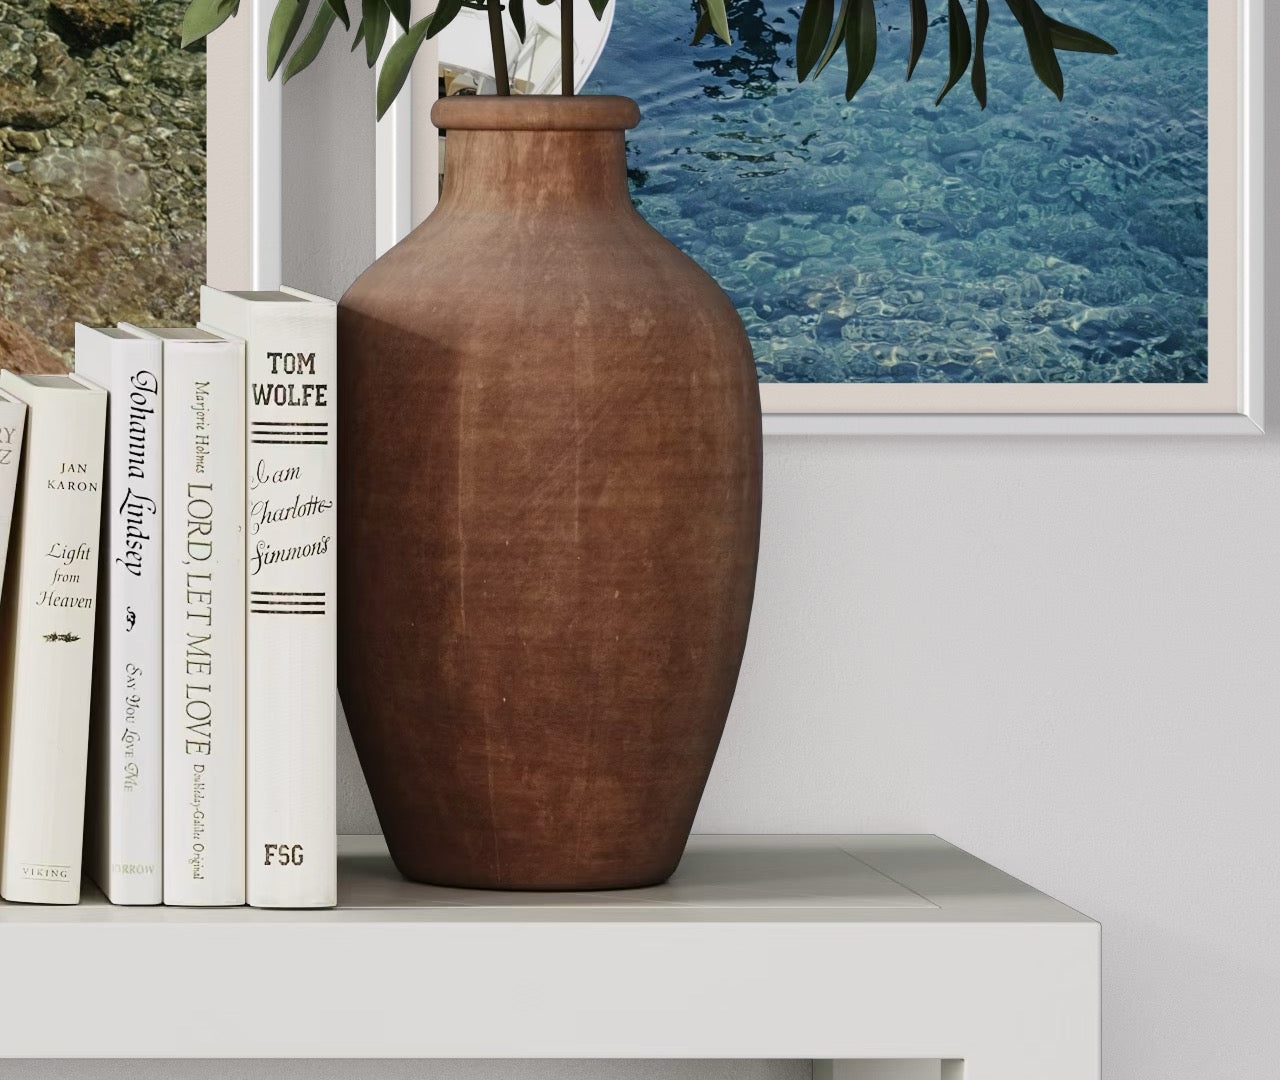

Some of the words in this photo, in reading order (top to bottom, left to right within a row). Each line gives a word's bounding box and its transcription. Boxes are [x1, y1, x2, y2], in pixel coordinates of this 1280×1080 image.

[267, 352, 316, 375] TOM
[191, 381, 210, 430] Marjorie
[252, 384, 328, 407] WOLFE
[128, 370, 158, 479] Johanna
[60, 462, 88, 474] JAN
[195, 434, 210, 474] Holmes
[47, 479, 98, 492] KARON
[250, 459, 270, 490] I
[272, 465, 302, 482] am
[116, 487, 157, 576] Lindsey
[182, 482, 213, 565] LORD,
[250, 494, 333, 535] Charlotte
[46, 543, 92, 565] Light
[52, 568, 80, 584] from
[36, 590, 92, 609] Heaven
[186, 572, 212, 626] LET
[186, 633, 212, 675] ME
[185, 683, 212, 755] LOVE
[188, 843, 205, 880] Original
[264, 843, 303, 866] FSG
[22, 867, 68, 879] VIKING
